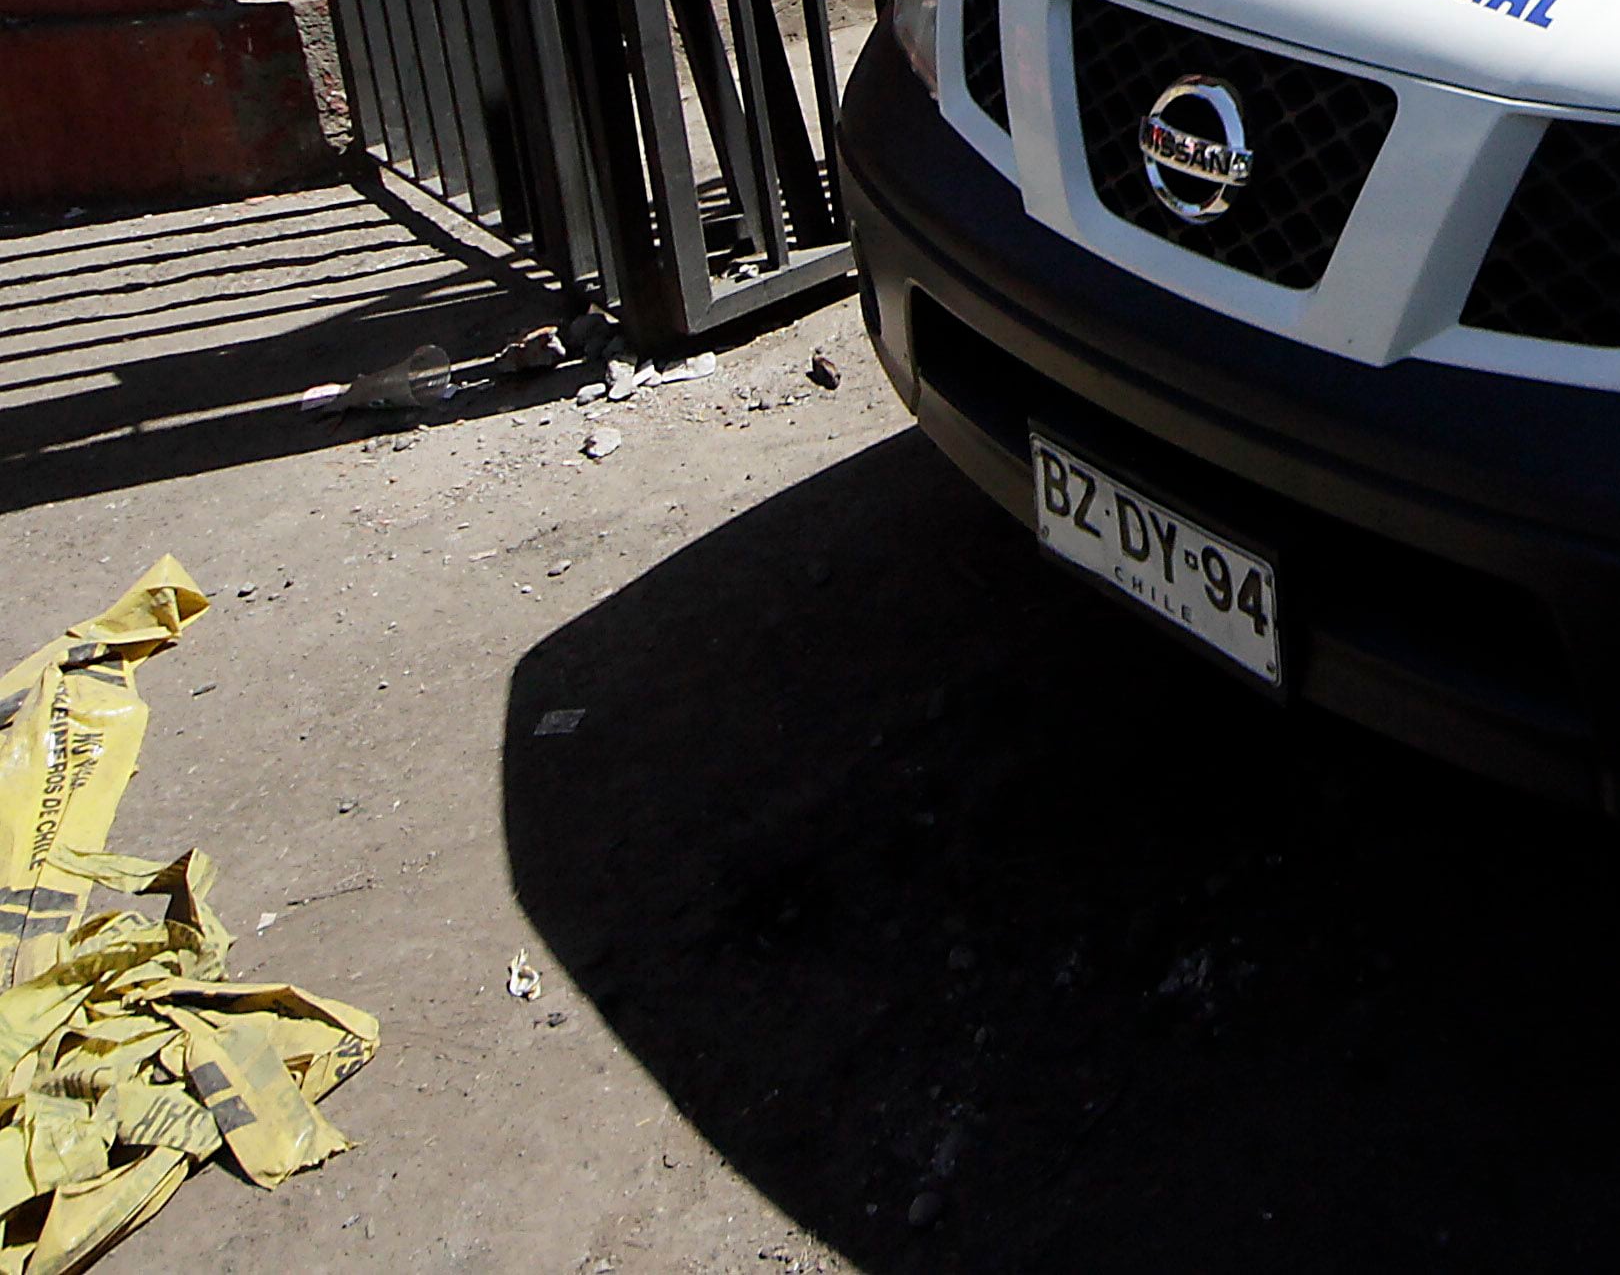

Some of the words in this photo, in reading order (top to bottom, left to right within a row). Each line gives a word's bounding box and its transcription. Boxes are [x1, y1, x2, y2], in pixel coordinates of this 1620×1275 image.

[1113, 566, 1192, 624] CHILE
[38, 797, 62, 818] DE
[29, 818, 57, 871] CHILE
